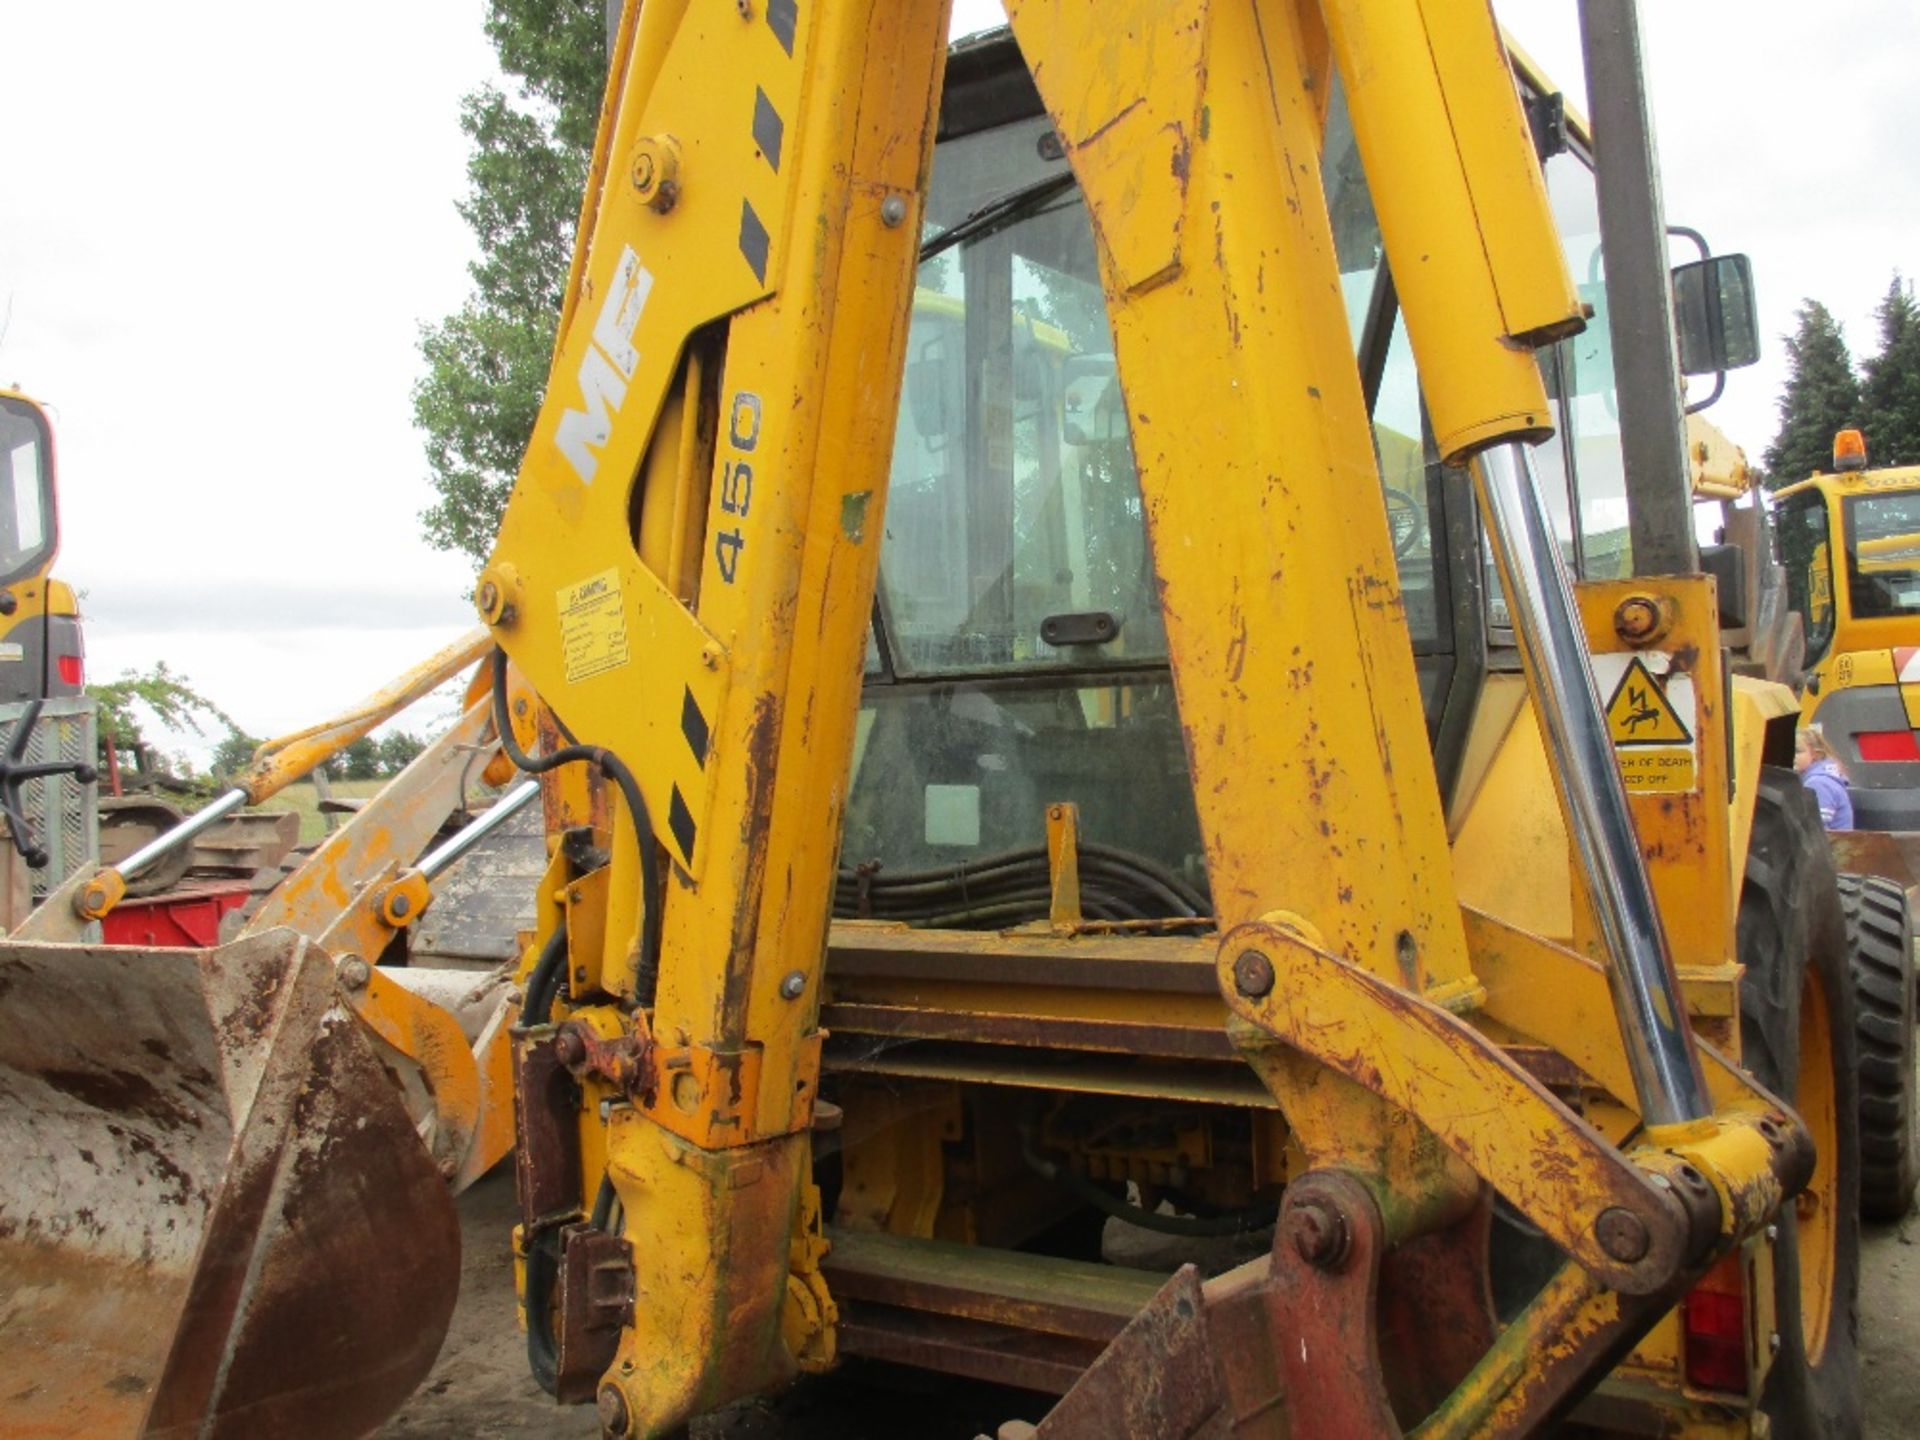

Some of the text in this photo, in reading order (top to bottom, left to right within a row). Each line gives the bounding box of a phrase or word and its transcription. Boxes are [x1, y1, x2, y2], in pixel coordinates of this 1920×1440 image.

[554, 243, 654, 486] MF
[715, 391, 761, 584] 450
[1623, 775, 1668, 784] EEP OFF
[1639, 758, 1653, 767] OF
[1658, 757, 1691, 767] DEATH
